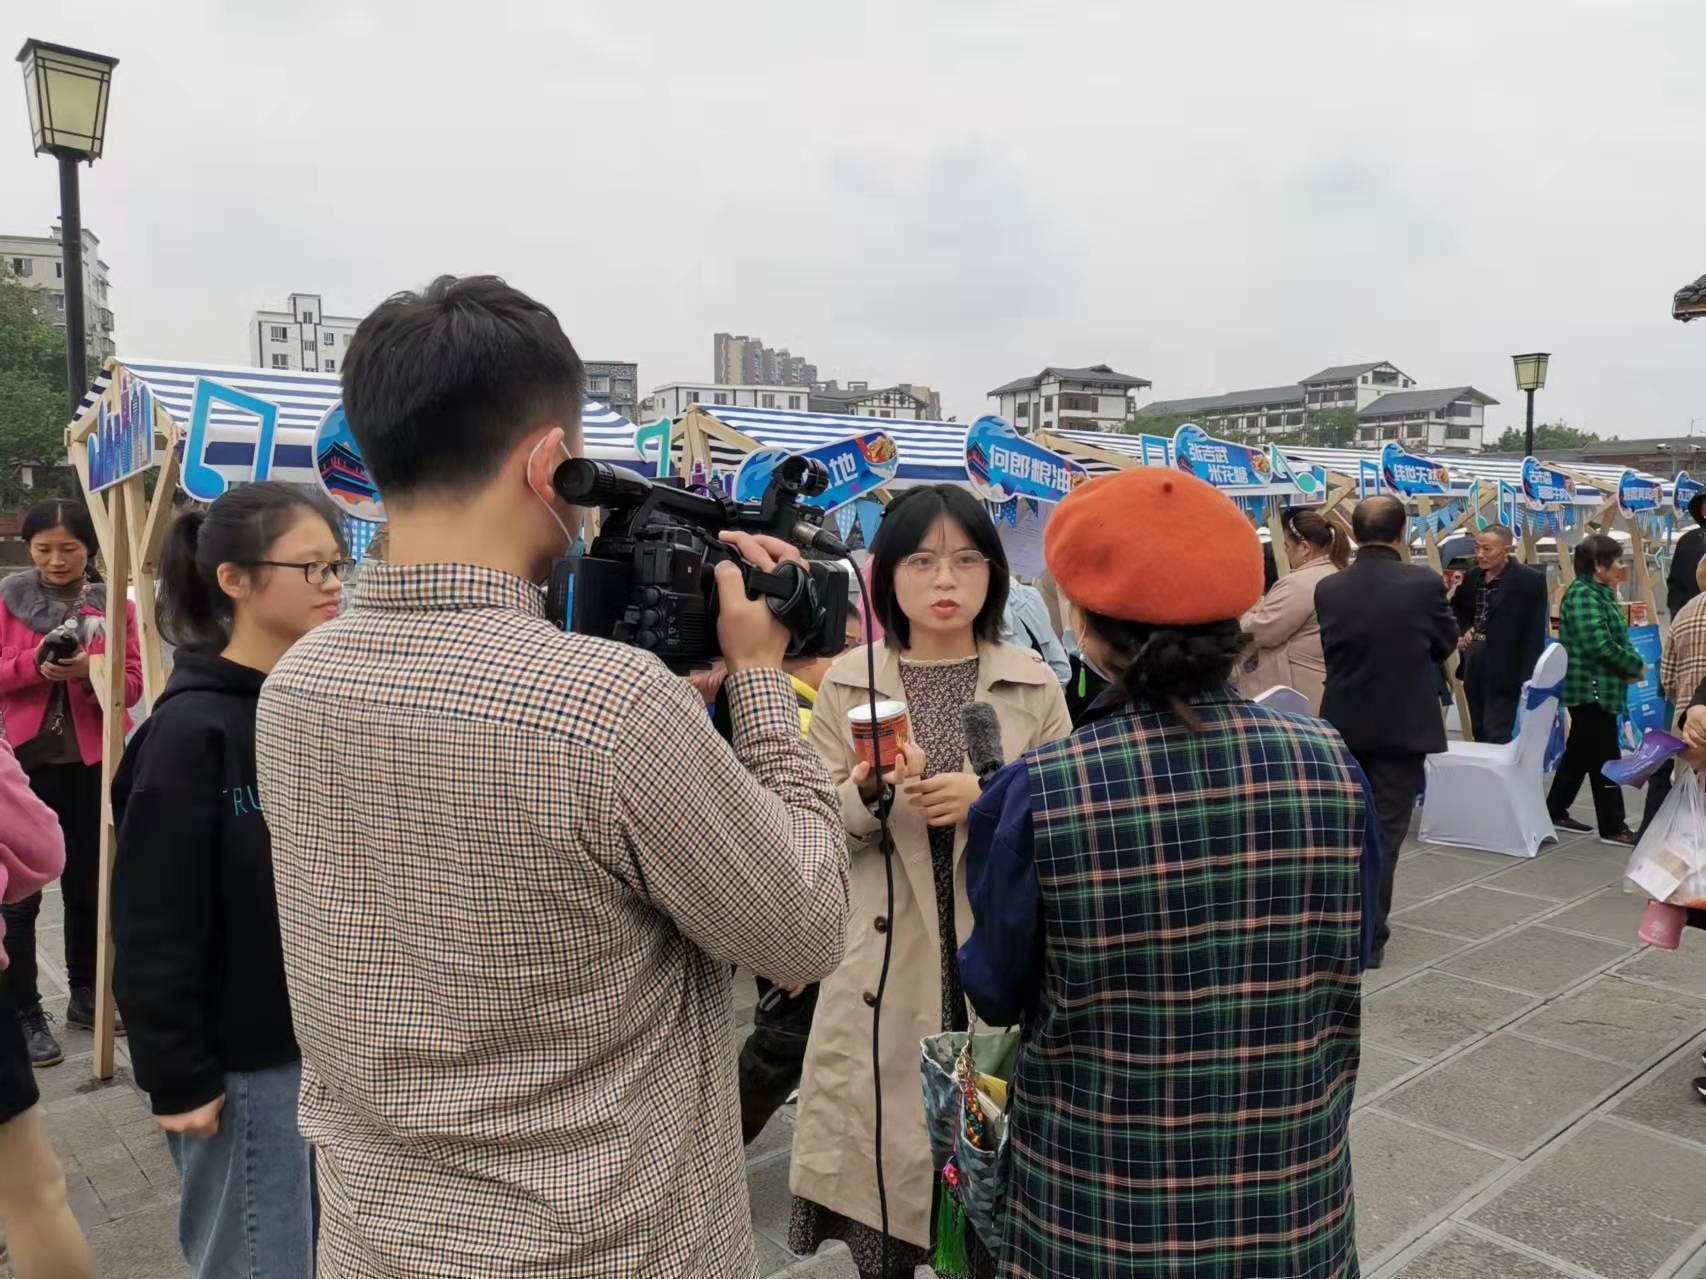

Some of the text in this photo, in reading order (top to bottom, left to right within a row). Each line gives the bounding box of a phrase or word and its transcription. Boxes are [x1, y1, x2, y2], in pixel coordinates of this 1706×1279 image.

[989, 443, 1072, 493] 何郎粮油
[1208, 463, 1249, 484] 米花糖
